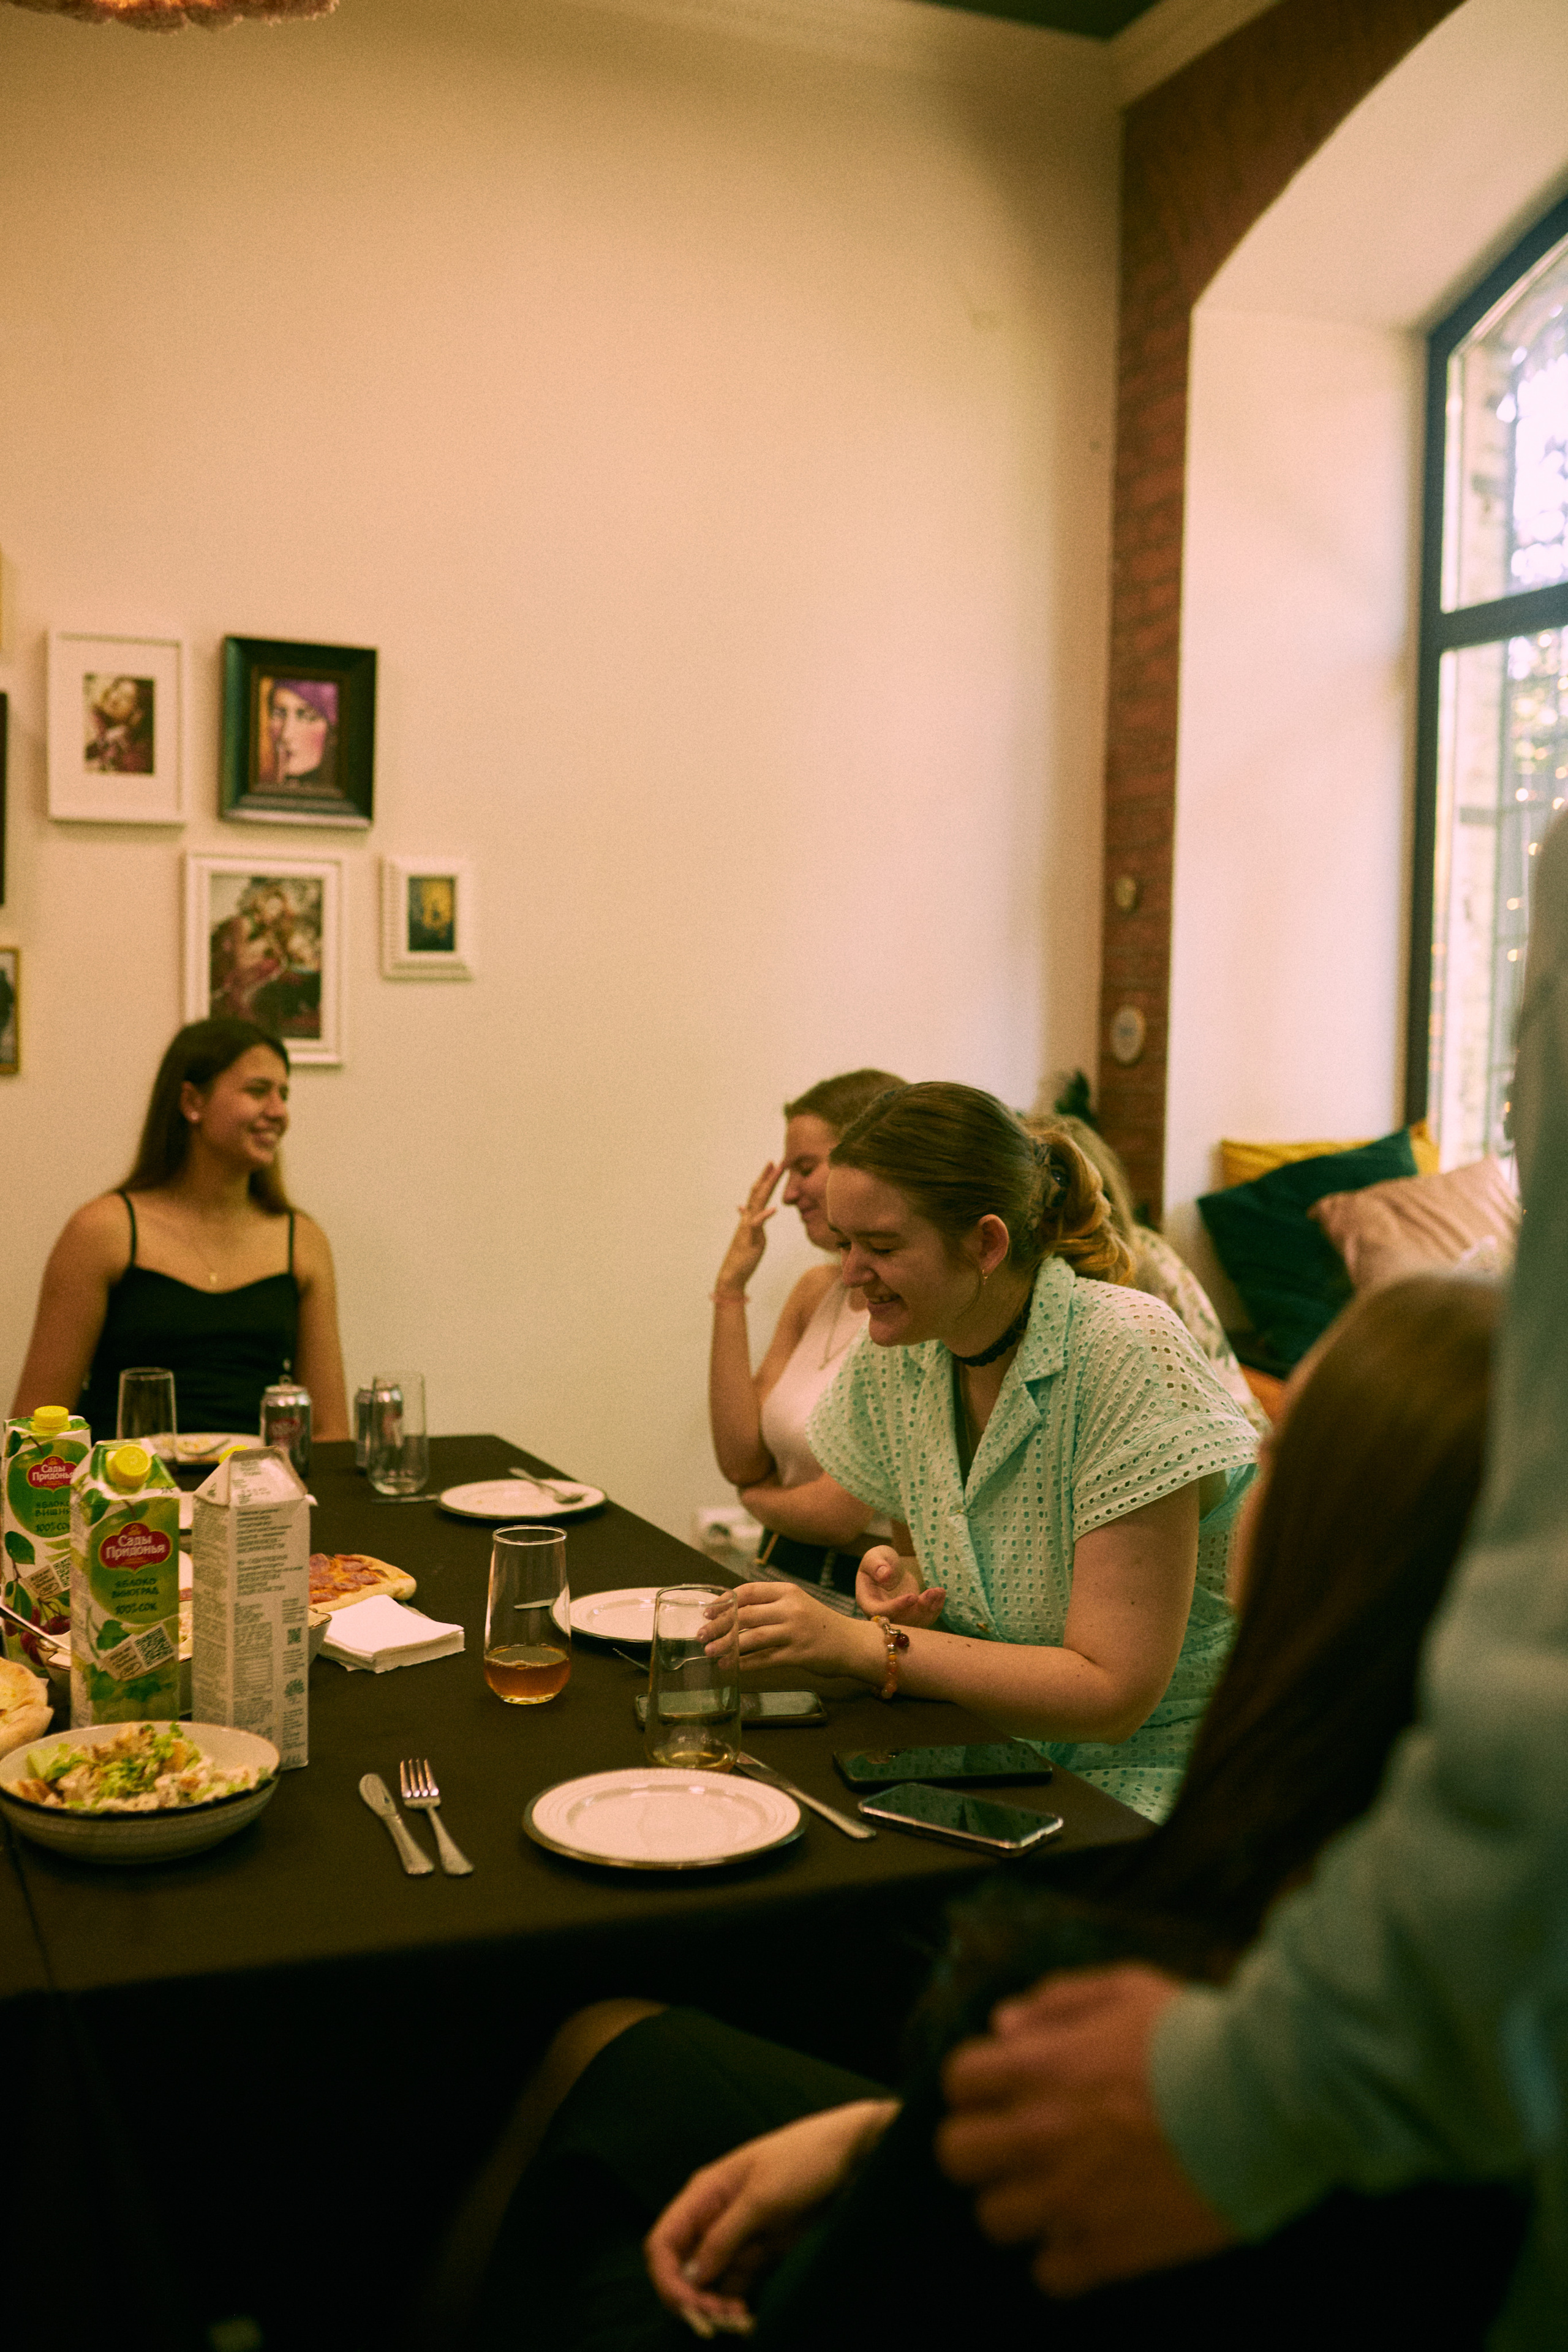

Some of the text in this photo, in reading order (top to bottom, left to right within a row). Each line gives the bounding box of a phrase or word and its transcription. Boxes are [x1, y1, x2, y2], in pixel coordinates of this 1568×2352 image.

[41, 1464, 66, 1473] Сады
[32, 1471, 74, 1482] Придонья
[118, 1535, 153, 1547] Сады
[105, 1544, 165, 1561] Придонья
[115, 1578, 157, 1588] ЯБЛОКО
